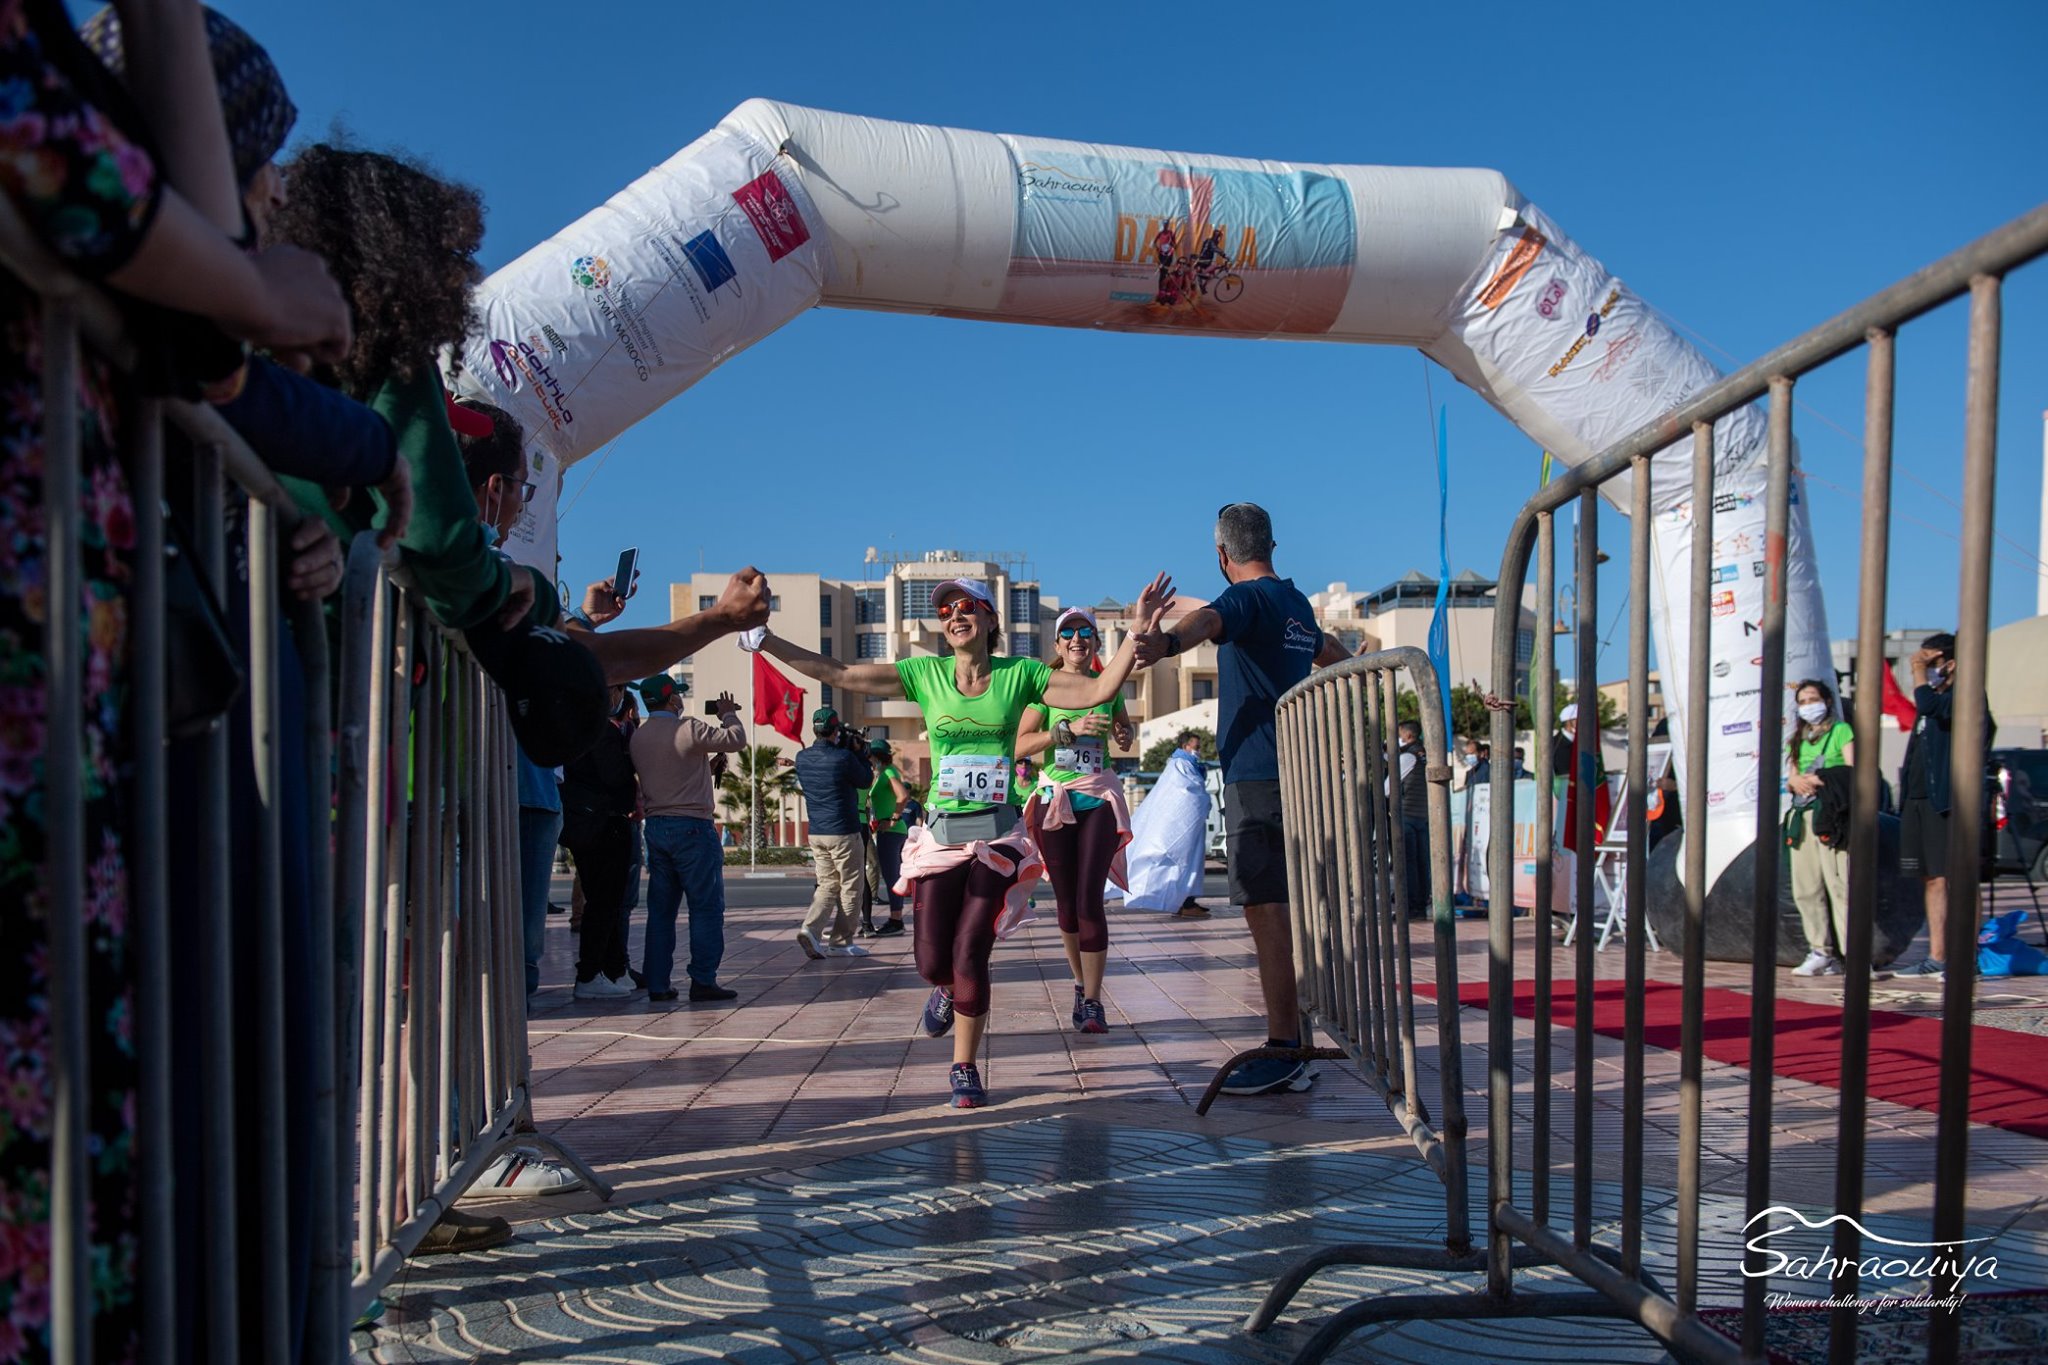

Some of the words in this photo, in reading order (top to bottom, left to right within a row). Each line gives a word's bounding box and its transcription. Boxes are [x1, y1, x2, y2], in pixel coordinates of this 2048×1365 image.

[541, 324, 568, 355] GROUPE
[593, 293, 619, 322] SMIT
[613, 322, 649, 382] MOROCCO
[1074, 749, 1091, 764] 16
[964, 771, 988, 789] 16
